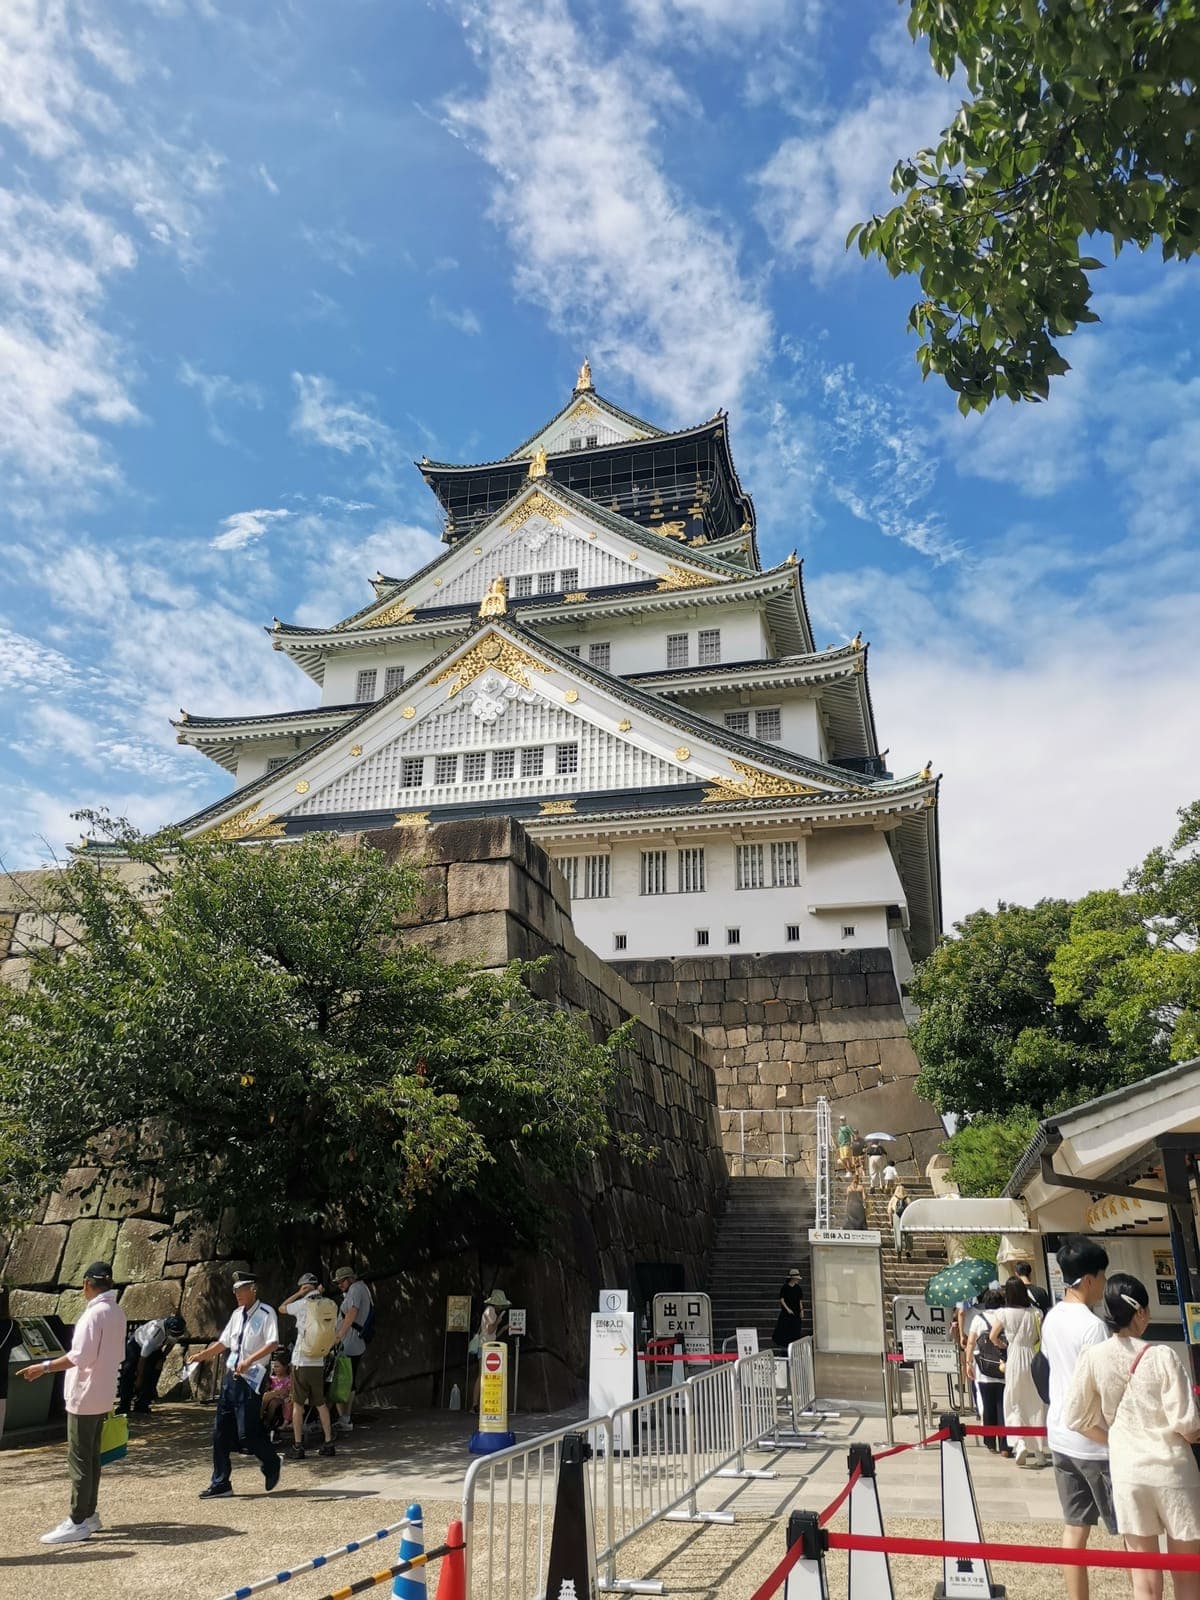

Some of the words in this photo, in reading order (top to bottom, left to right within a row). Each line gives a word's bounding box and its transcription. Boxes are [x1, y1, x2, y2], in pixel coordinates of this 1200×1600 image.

[823, 1232, 851, 1240] 団体入口
[664, 1302, 701, 1317] 出口
[905, 1306, 945, 1322] 入口
[596, 1319, 624, 1328] 団体入口
[668, 1321, 695, 1330] EXIT
